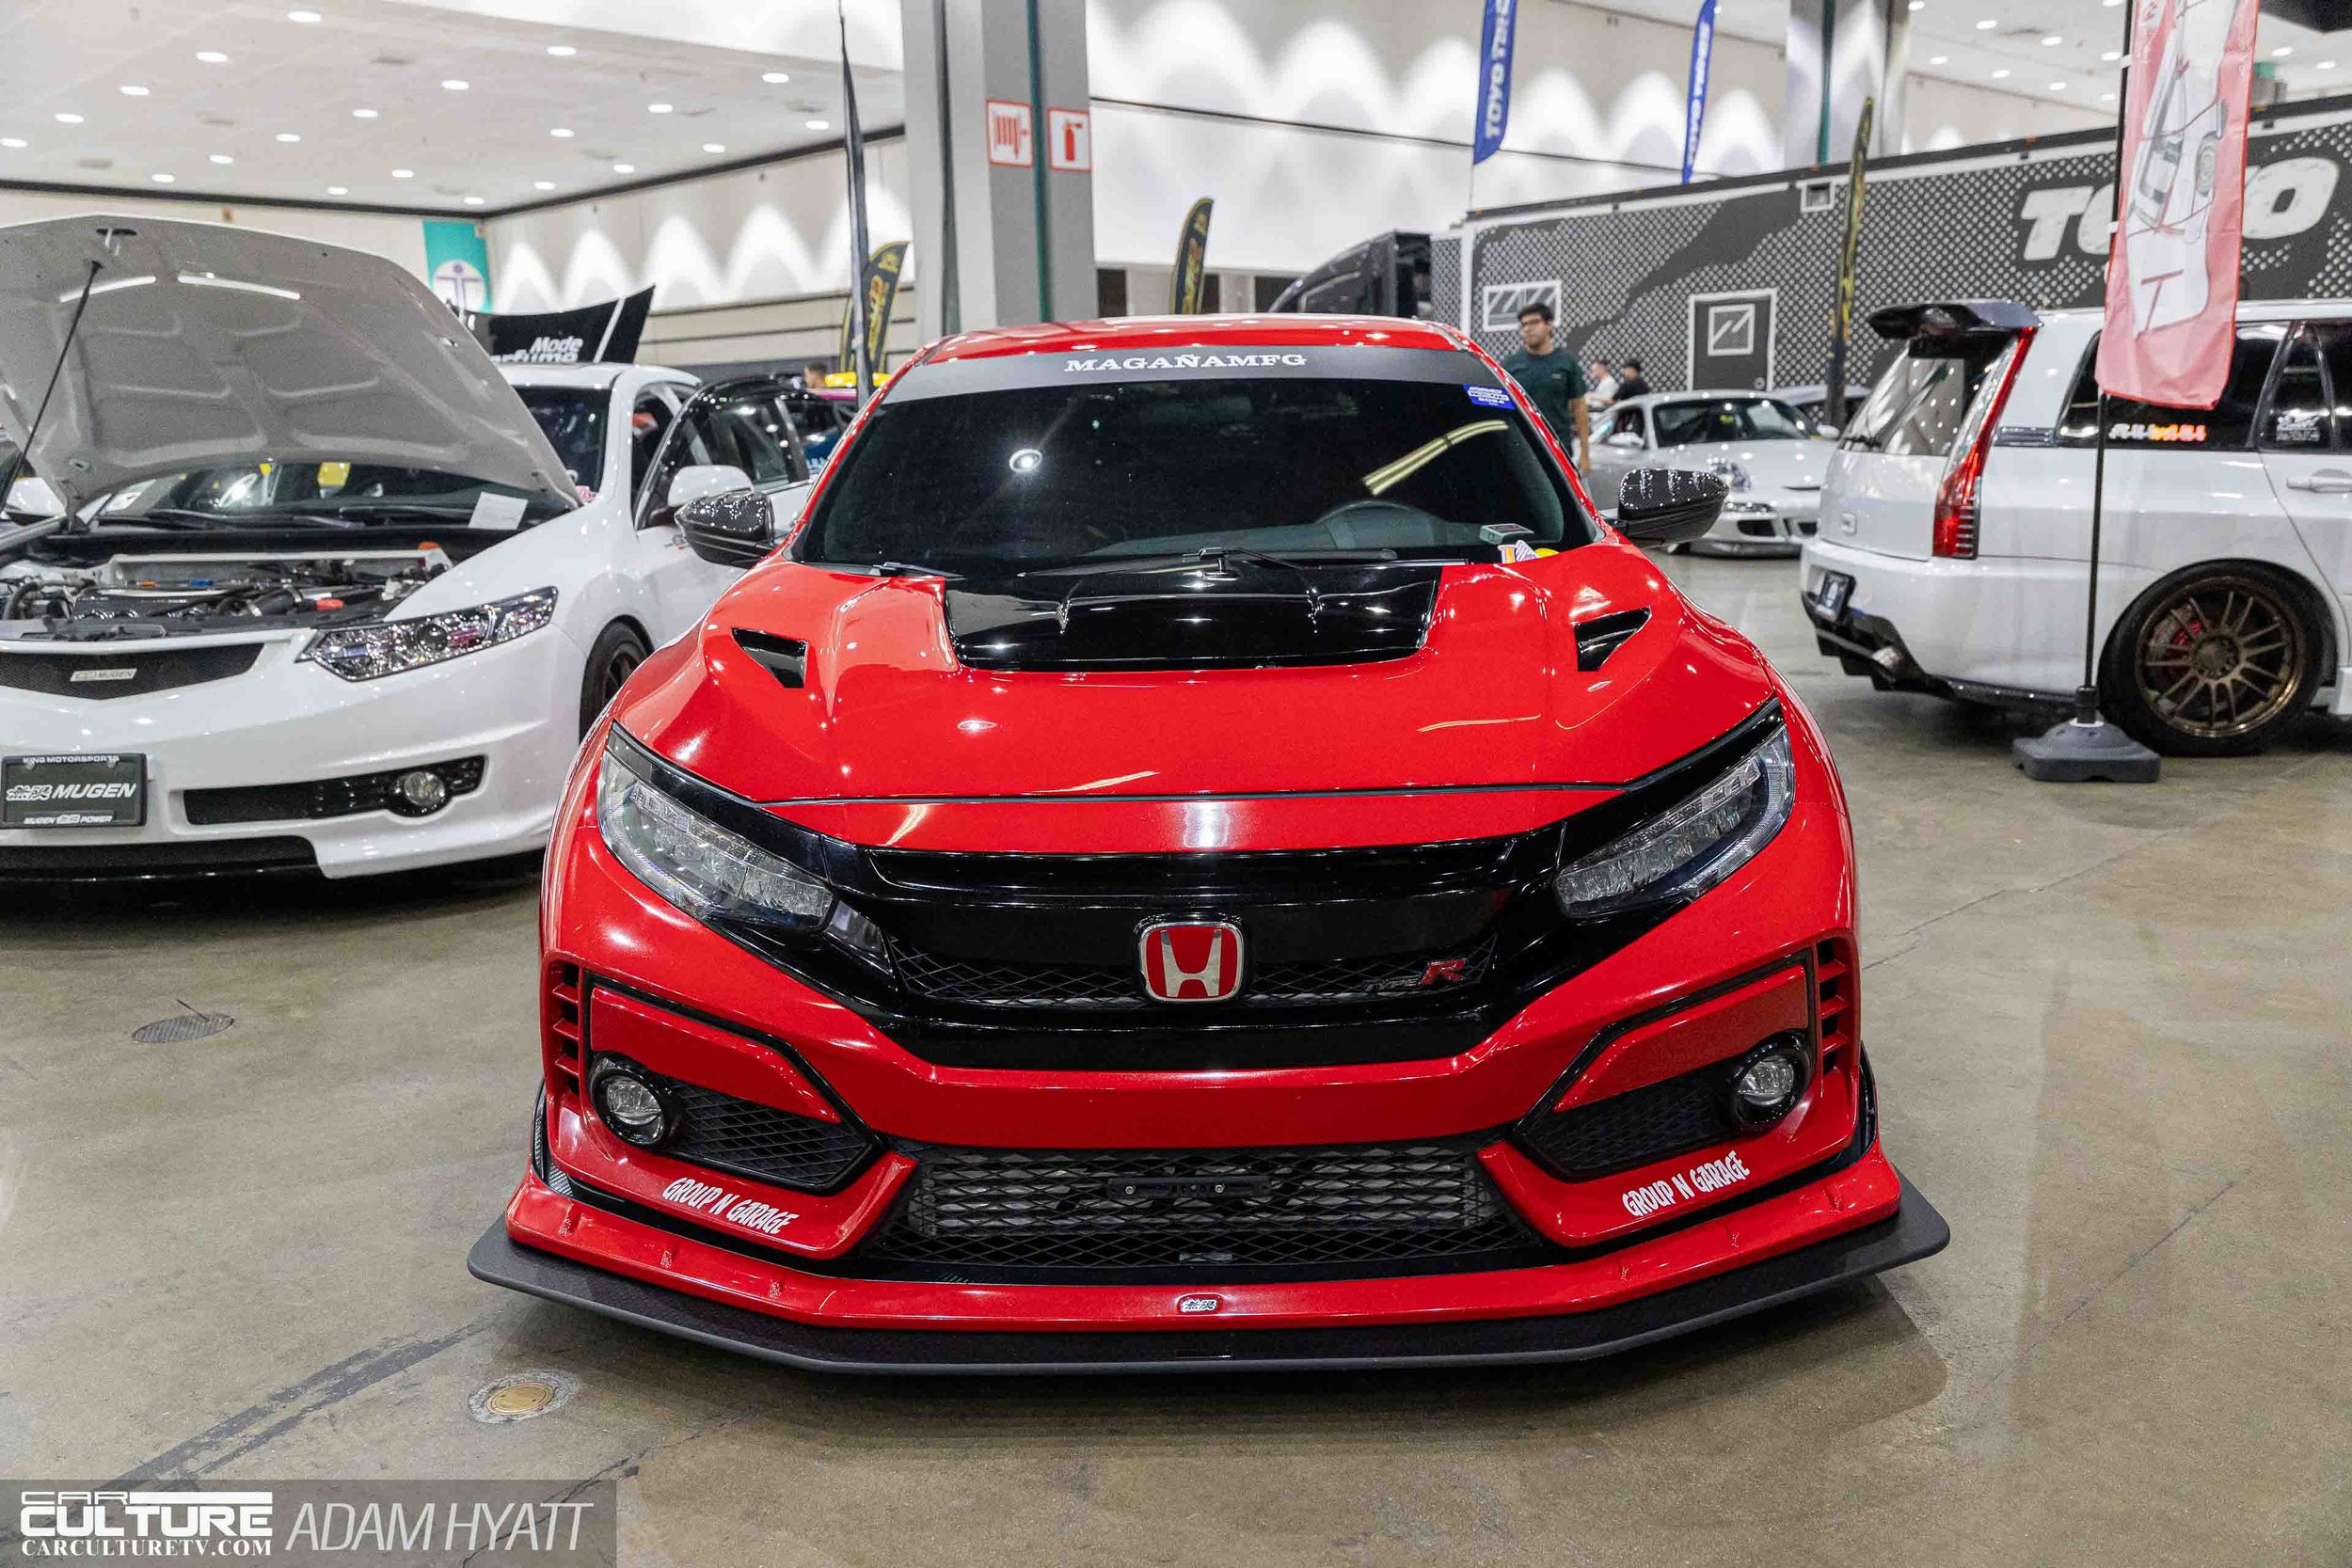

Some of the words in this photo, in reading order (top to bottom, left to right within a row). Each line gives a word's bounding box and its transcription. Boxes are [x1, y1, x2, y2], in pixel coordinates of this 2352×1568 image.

[1485, 62, 1505, 139] TOYO
[530, 335, 584, 353] Mode
[1064, 354, 1307, 372] MAGAÑAMFG
[52, 783, 136, 799] MUGEN
[1622, 1180, 1677, 1217] GROUP
[1671, 1173, 1695, 1200] N
[1689, 1149, 1751, 1193] GARAGE
[661, 1177, 723, 1210] GROUP
[707, 1193, 740, 1215] N
[725, 1198, 800, 1234] GARAGE
